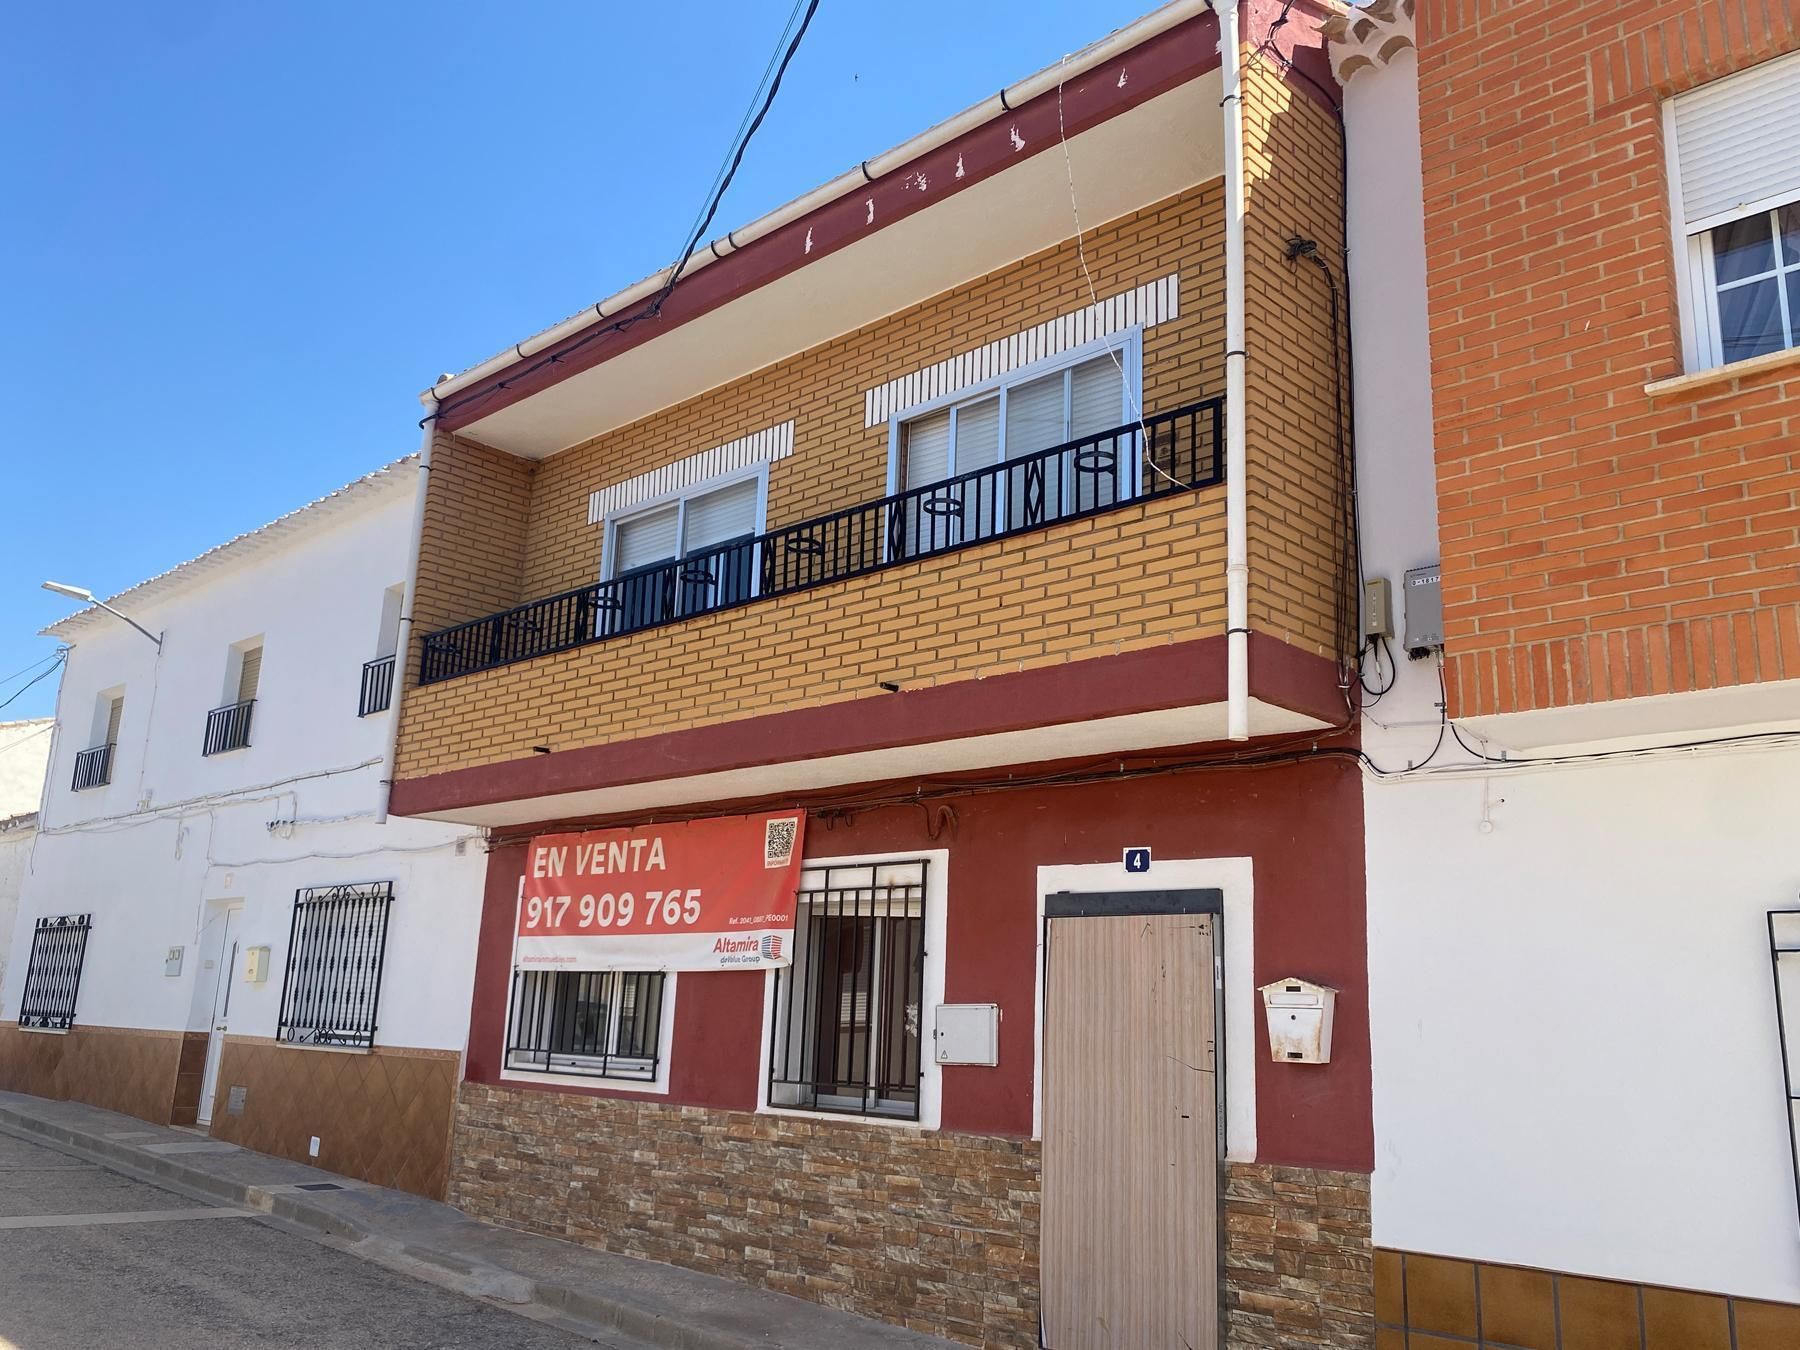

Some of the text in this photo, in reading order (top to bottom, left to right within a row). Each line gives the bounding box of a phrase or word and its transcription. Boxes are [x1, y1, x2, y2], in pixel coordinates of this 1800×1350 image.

[533, 837, 666, 878] EN VENTA
[1133, 852, 1142, 869] 4
[526, 888, 701, 928] 917 909 765
[713, 936, 759, 952] Altamira
[742, 954, 760, 963] Group
